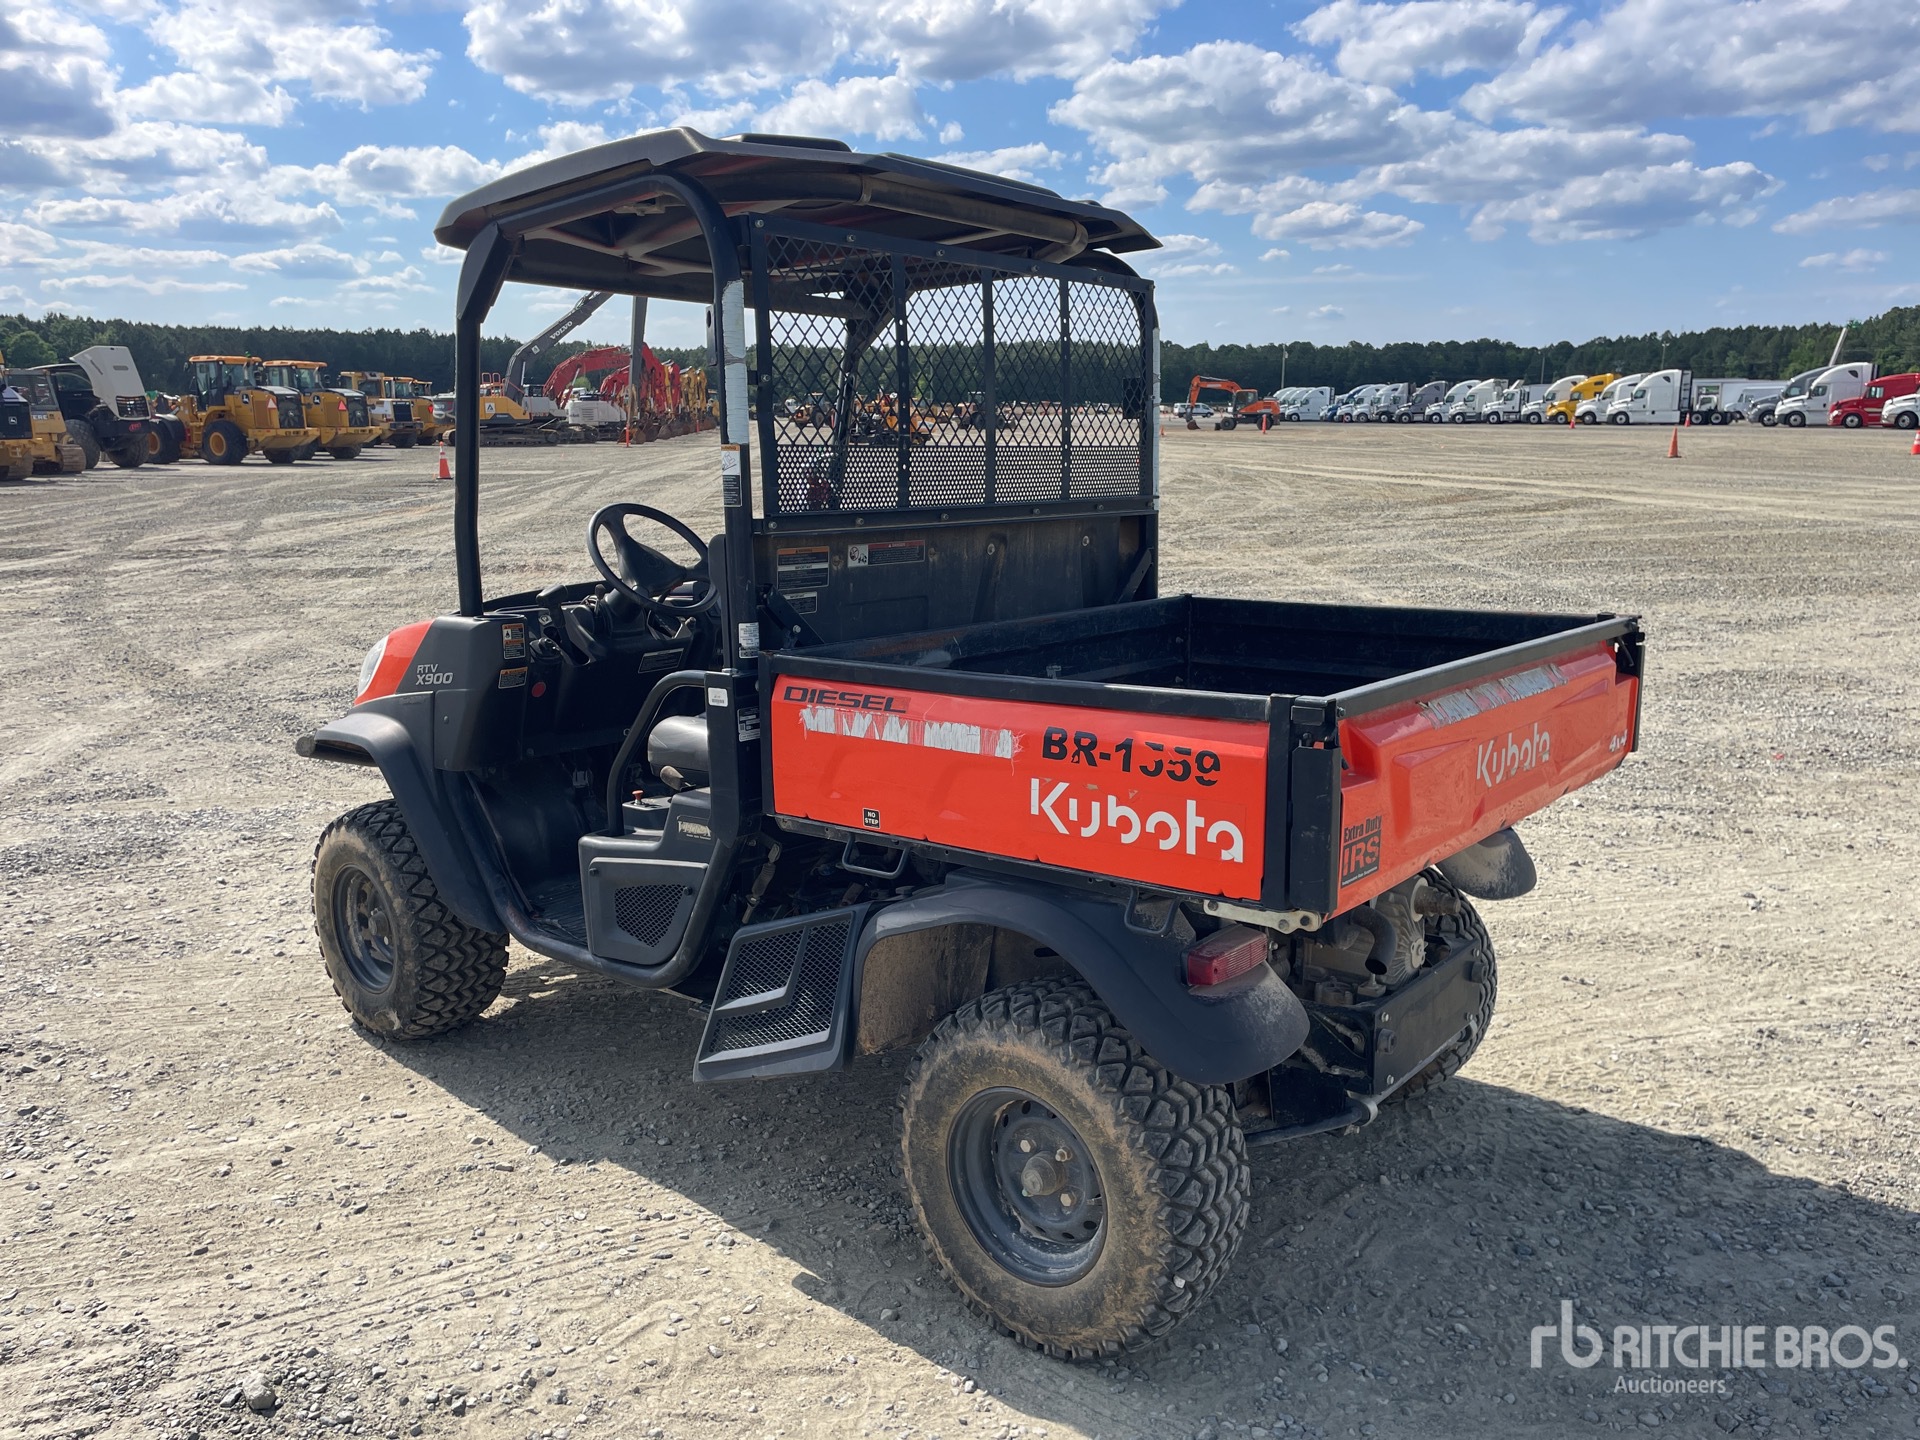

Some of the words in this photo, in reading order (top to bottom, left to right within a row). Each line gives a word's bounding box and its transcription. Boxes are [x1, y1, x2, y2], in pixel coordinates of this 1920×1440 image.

[550, 321, 573, 339] VOLVO
[416, 672, 453, 685] X900
[417, 664, 438, 674] RTV
[784, 686, 906, 713] DIESEL
[1476, 722, 1550, 788] Kubota
[864, 817, 879, 825] STEP
[1030, 777, 1244, 864] Kubota
[1344, 823, 1364, 843] Extra
[1366, 815, 1382, 834] Duty
[1343, 835, 1380, 877] IRS
